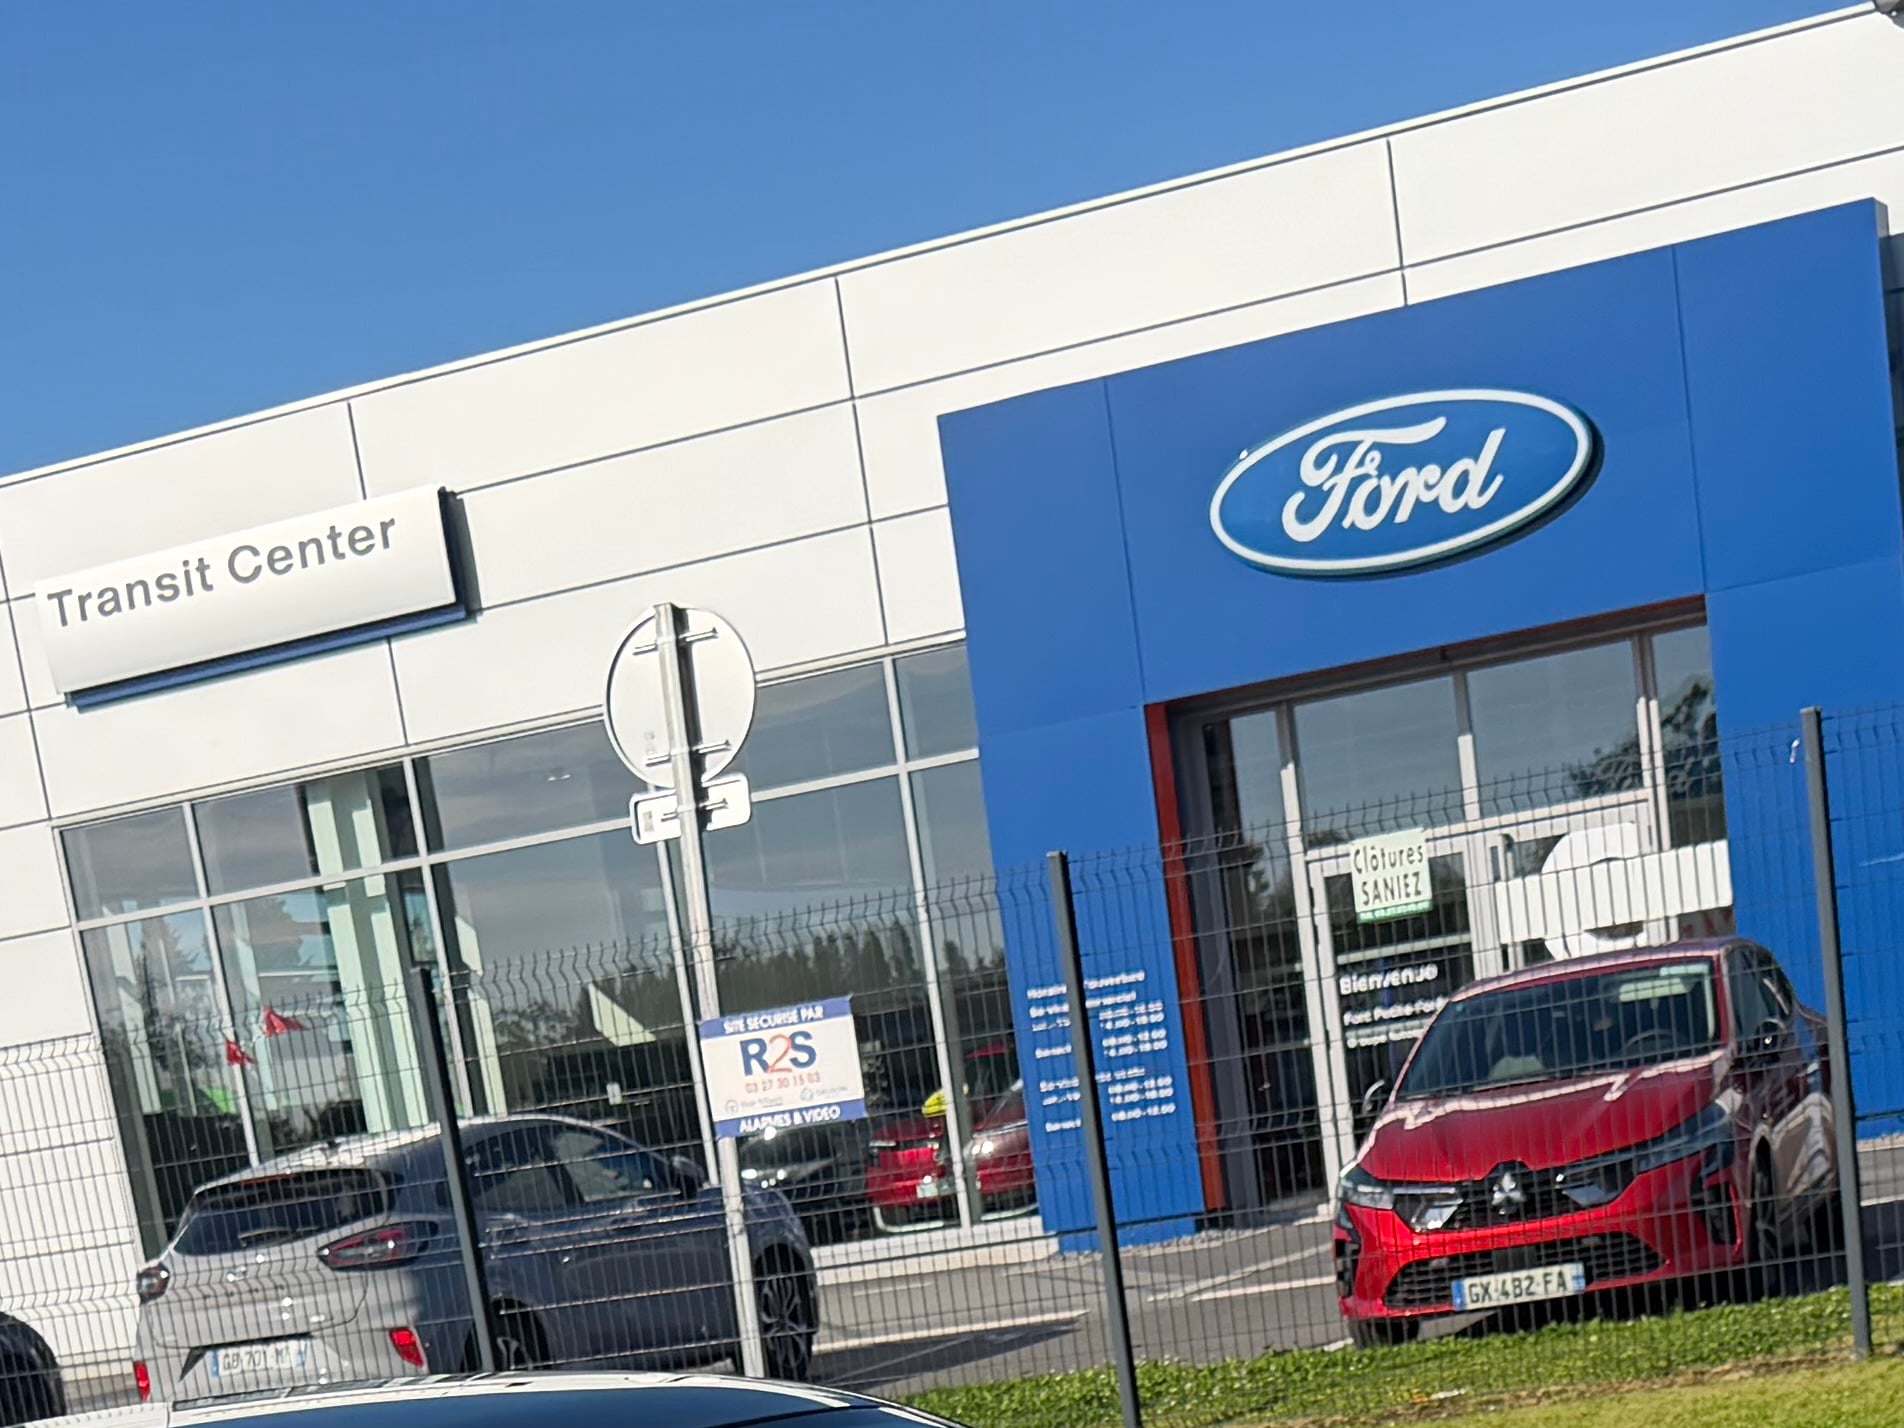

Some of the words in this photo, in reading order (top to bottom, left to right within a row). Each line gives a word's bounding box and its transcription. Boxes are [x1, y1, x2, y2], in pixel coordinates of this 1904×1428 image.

[1281, 416, 1505, 543] Ford
[47, 556, 213, 628] Transit
[226, 514, 398, 584] Center
[1353, 844, 1424, 876] Clôtures
[1361, 871, 1422, 907] SANIEZ
[800, 1004, 825, 1021] PAR
[739, 1030, 818, 1077] R2S
